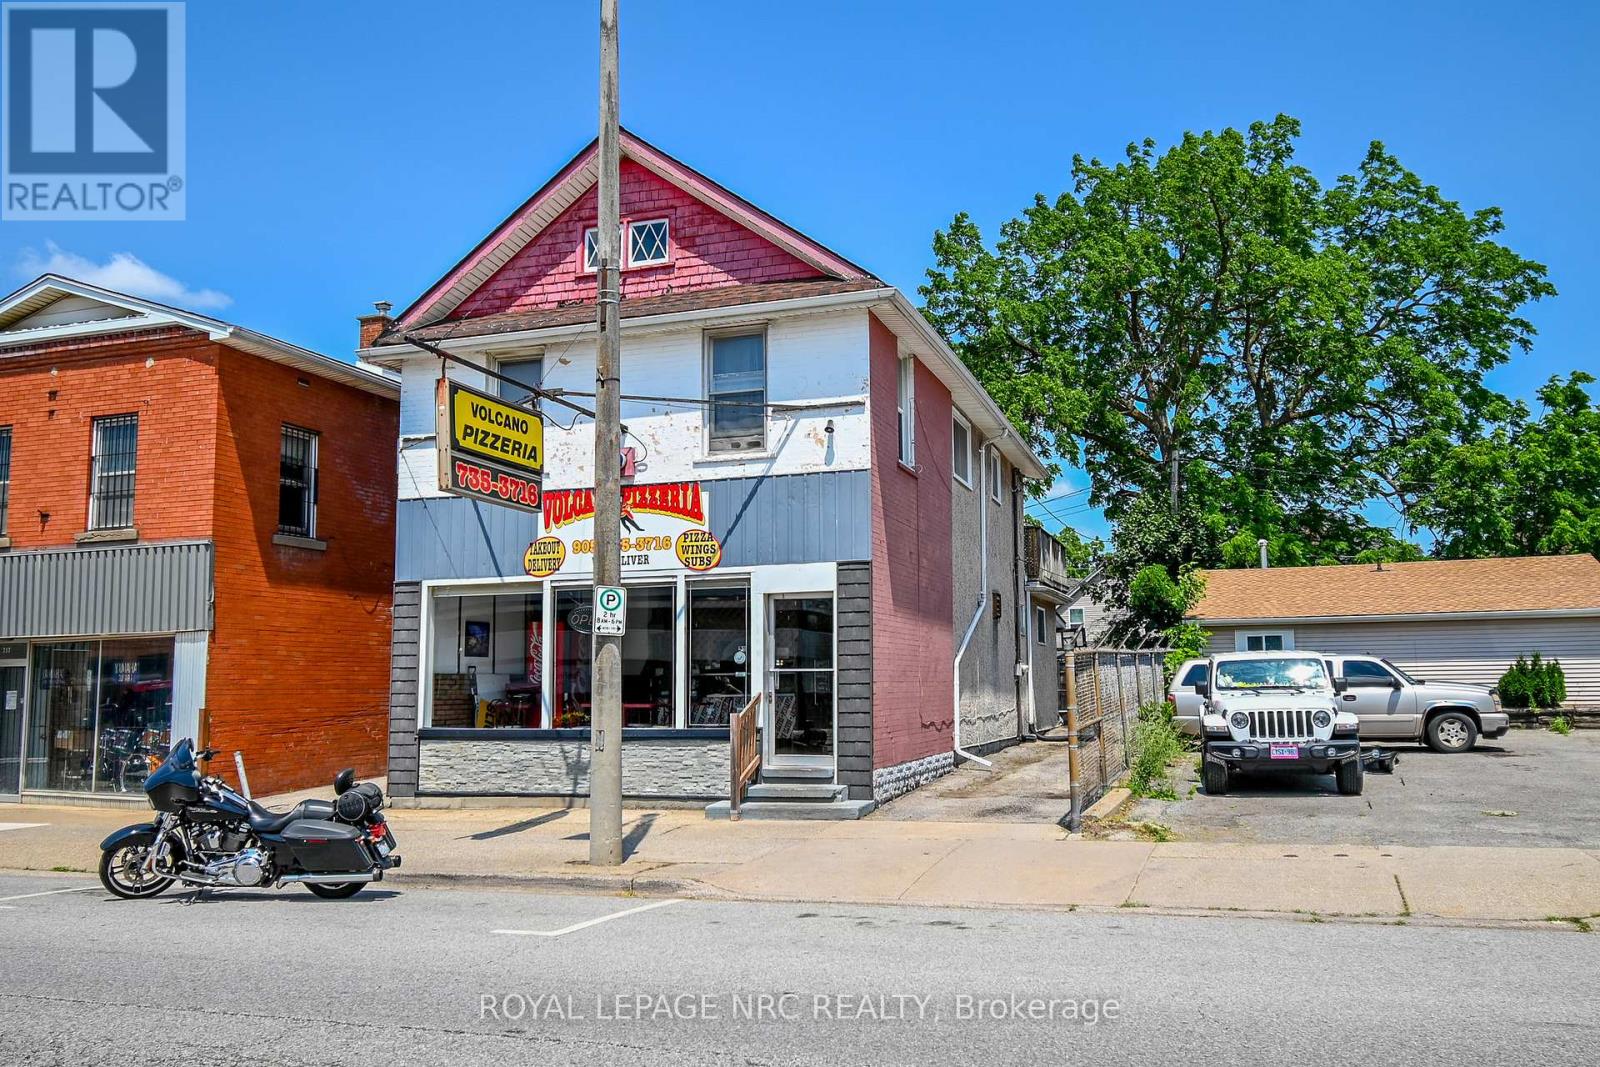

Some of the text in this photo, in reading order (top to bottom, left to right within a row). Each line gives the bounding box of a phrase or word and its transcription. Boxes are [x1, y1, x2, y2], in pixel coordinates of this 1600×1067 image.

[471, 402, 528, 434] VOLCANO
[463, 424, 538, 462] PIZZERIA
[456, 461, 538, 506] 735-3716
[543, 489, 596, 534] VOLCA
[683, 532, 714, 543] PIZZA
[530, 541, 560, 555] TAKEOUT
[681, 544, 716, 555] WINGS
[528, 557, 561, 572] DELIVERY
[620, 554, 650, 566] LIVER
[684, 555, 712, 568] SUBS
[606, 594, 616, 606] P
